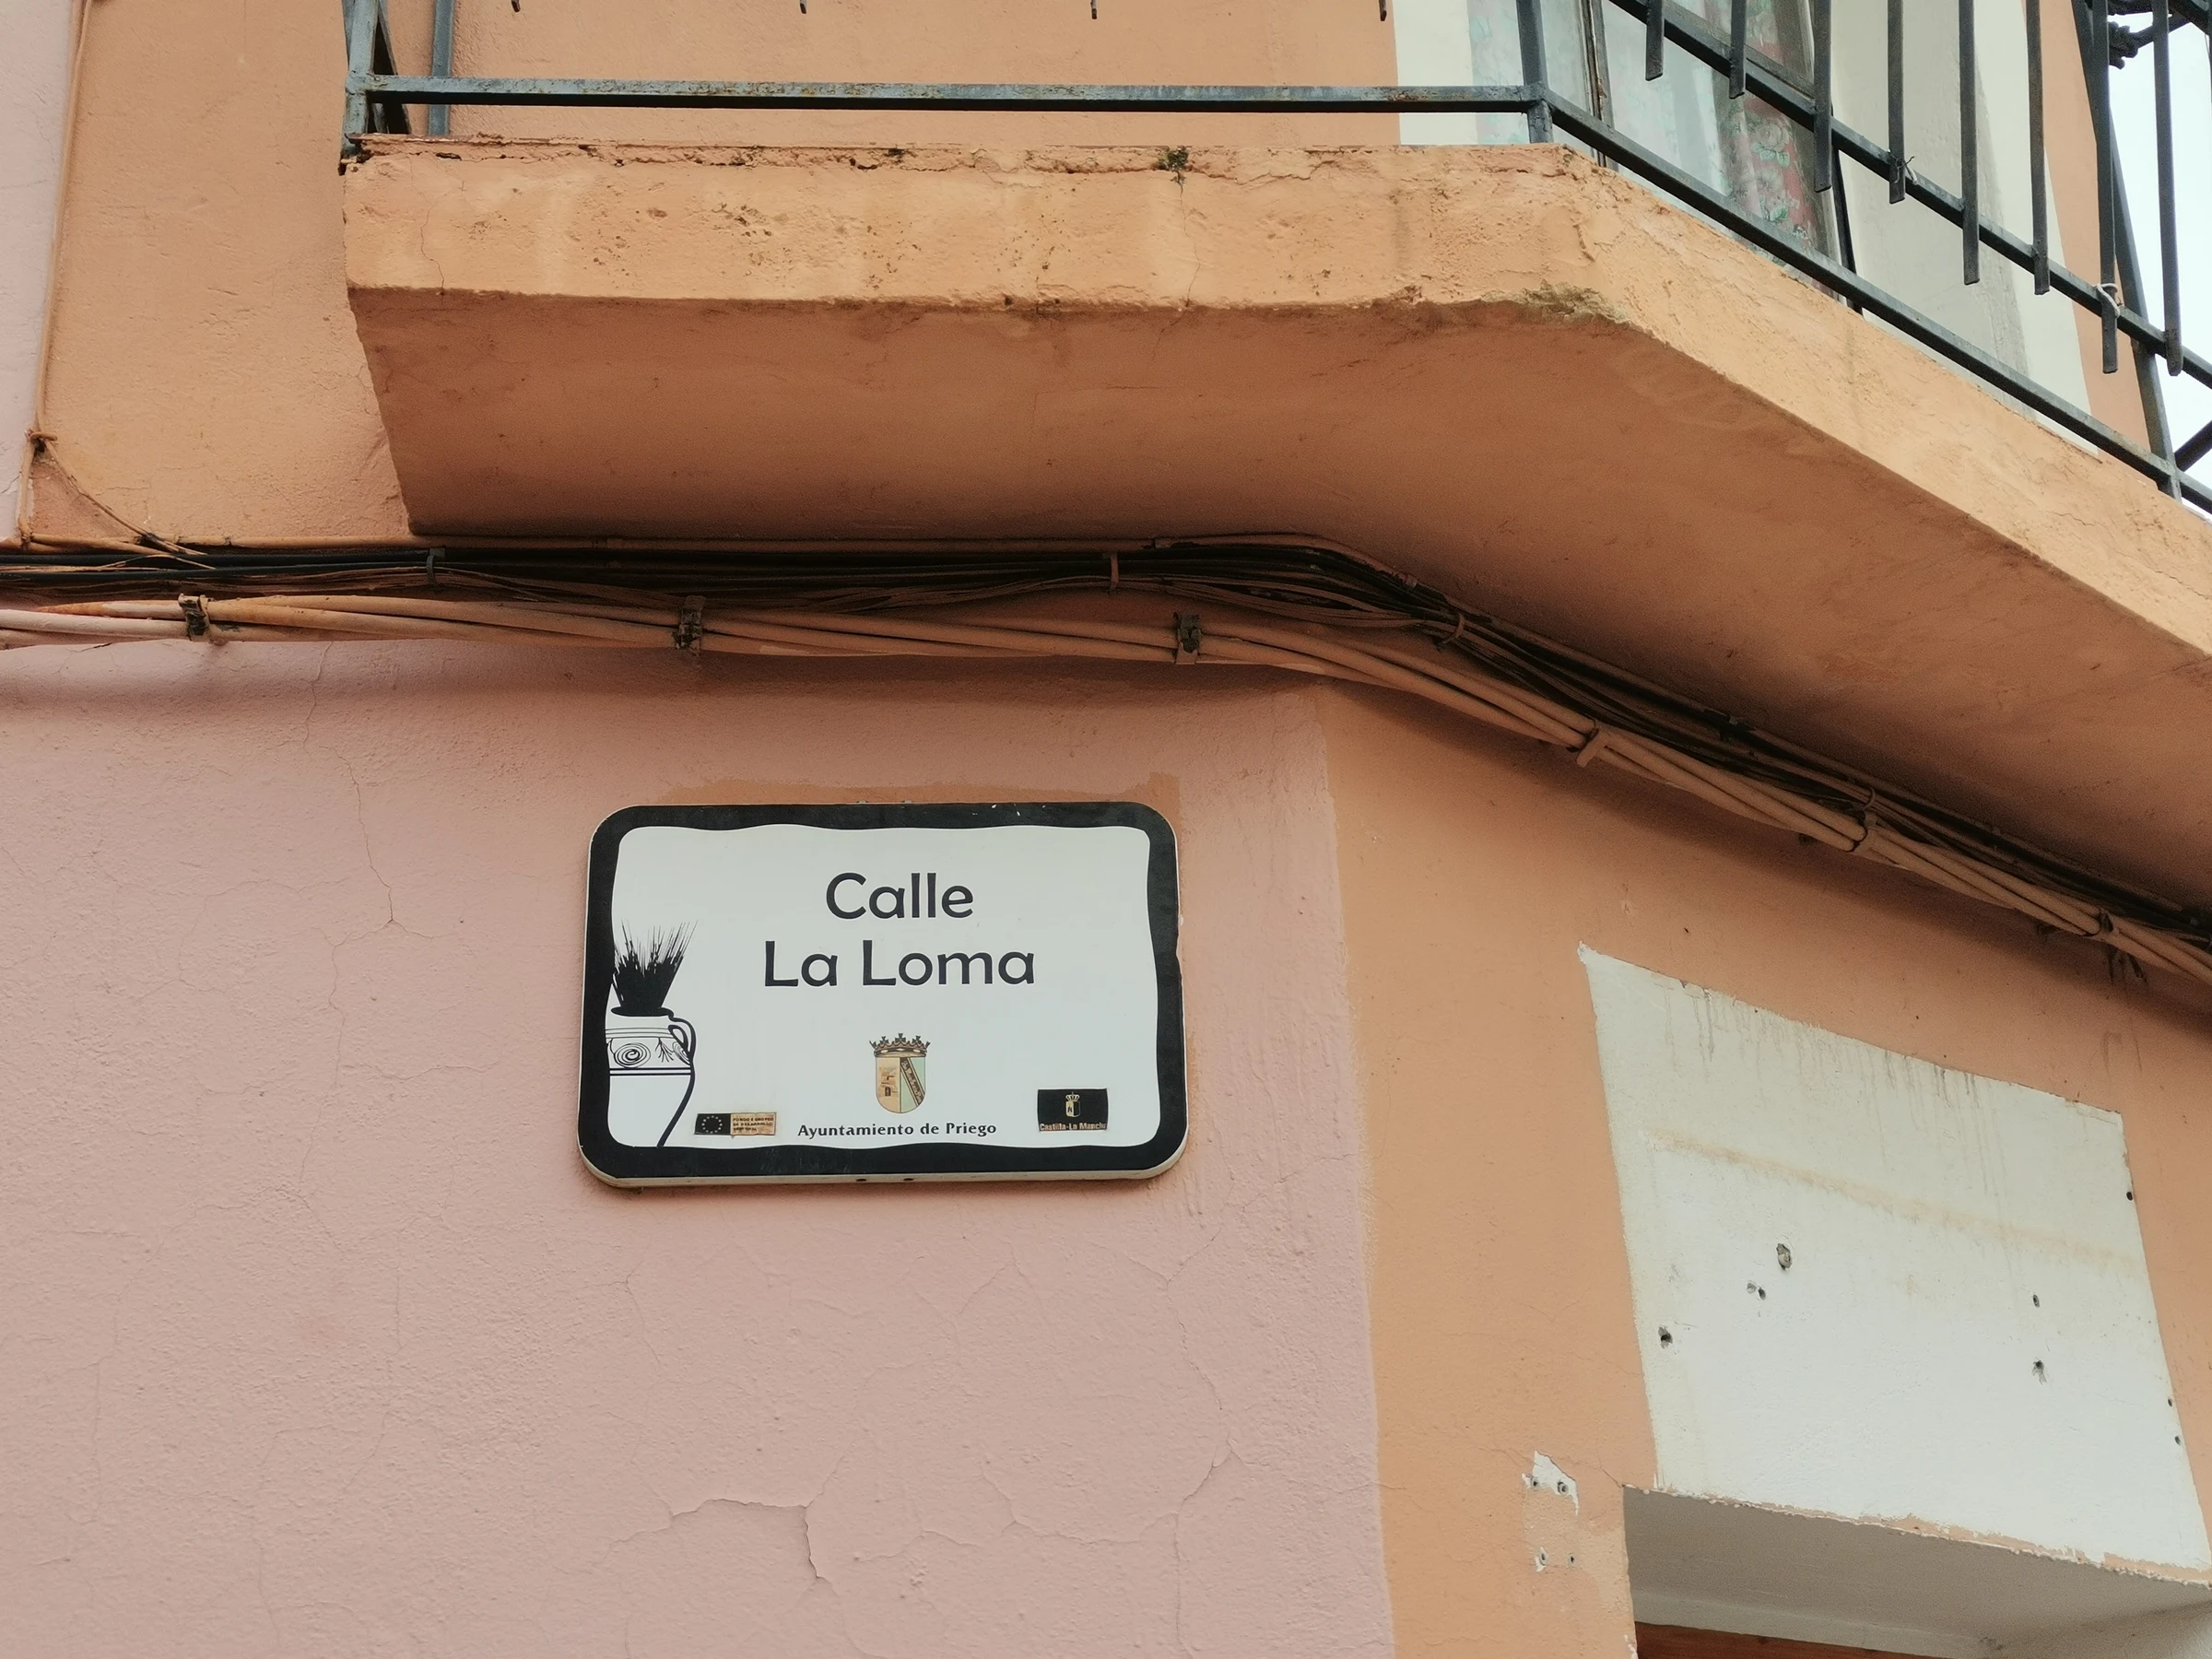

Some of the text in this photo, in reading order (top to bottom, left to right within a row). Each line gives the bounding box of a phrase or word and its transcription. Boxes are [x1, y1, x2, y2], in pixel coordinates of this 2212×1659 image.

[826, 872, 973, 919] Calle
[765, 939, 1034, 986] La Loma
[797, 1122, 996, 1139] Ayuntamiento de Priego
